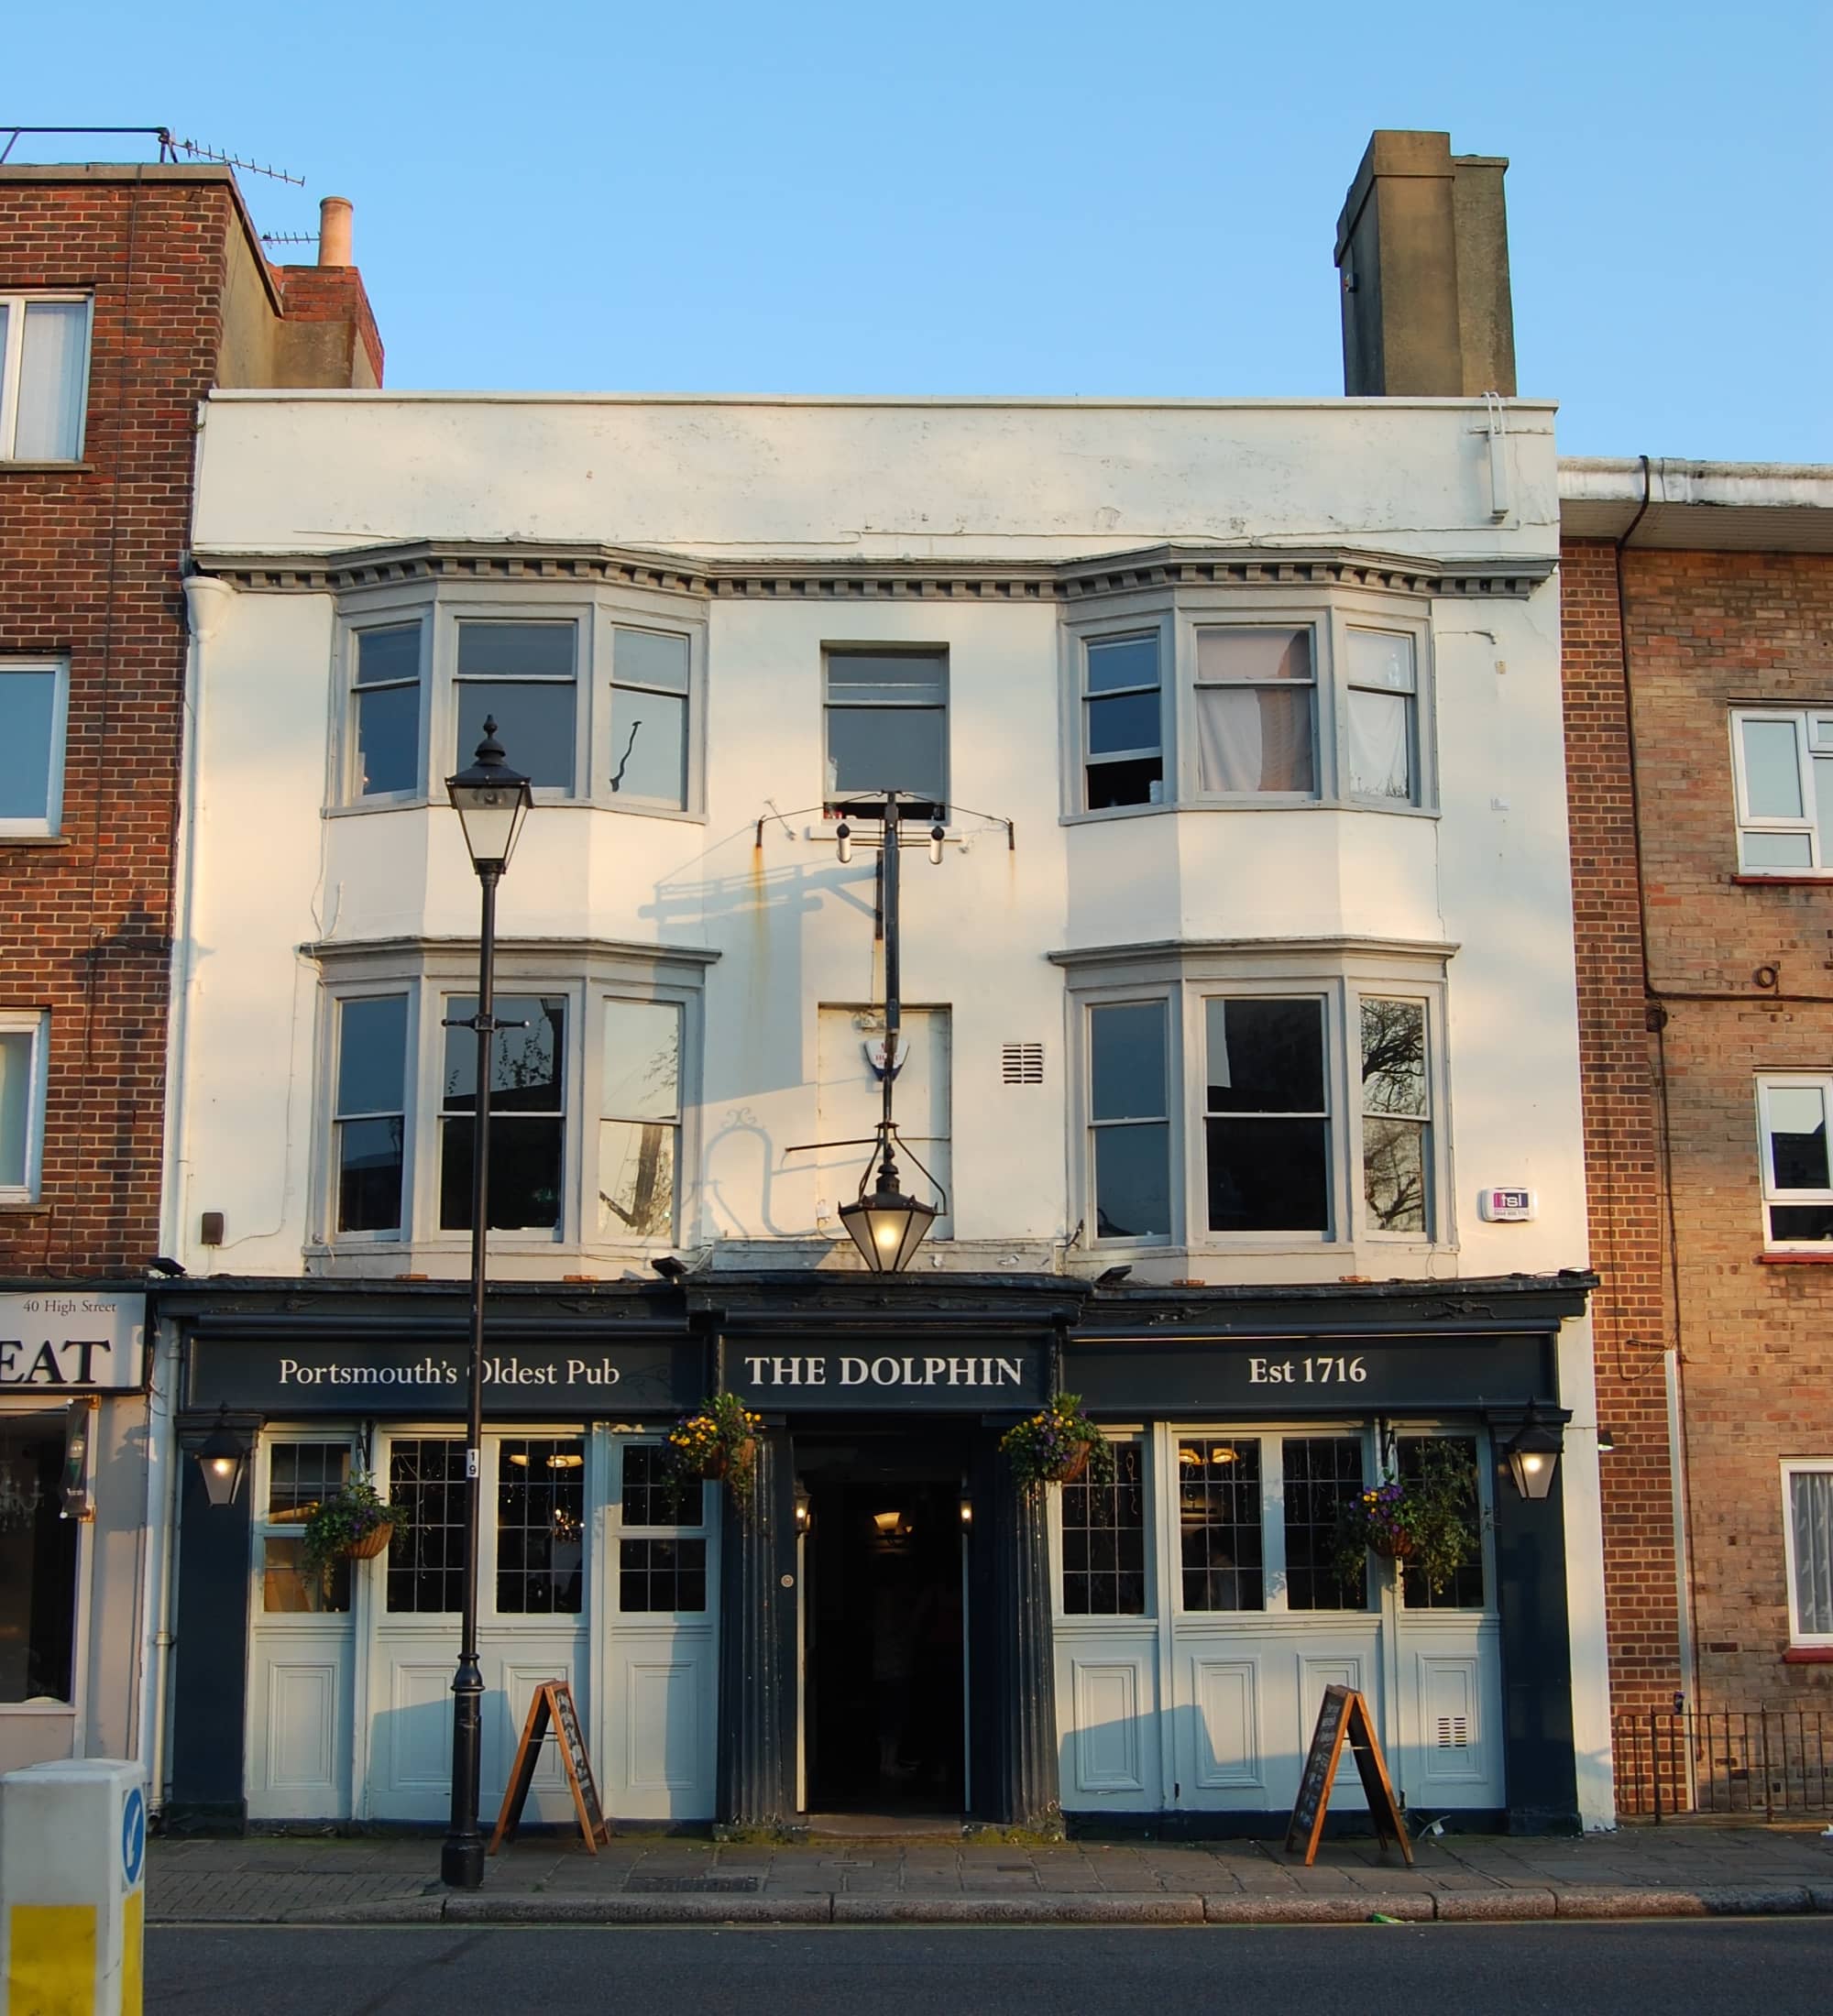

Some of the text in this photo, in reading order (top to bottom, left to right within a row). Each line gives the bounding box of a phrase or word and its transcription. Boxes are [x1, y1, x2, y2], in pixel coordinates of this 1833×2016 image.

[23, 1299, 117, 1317] 40 High Street
[279, 1357, 457, 1384] Portsmouth’s
[565, 1357, 620, 1385] Pub
[744, 1357, 1025, 1386] THE DOLPHIN
[1248, 1356, 1367, 1383] Est 1716
